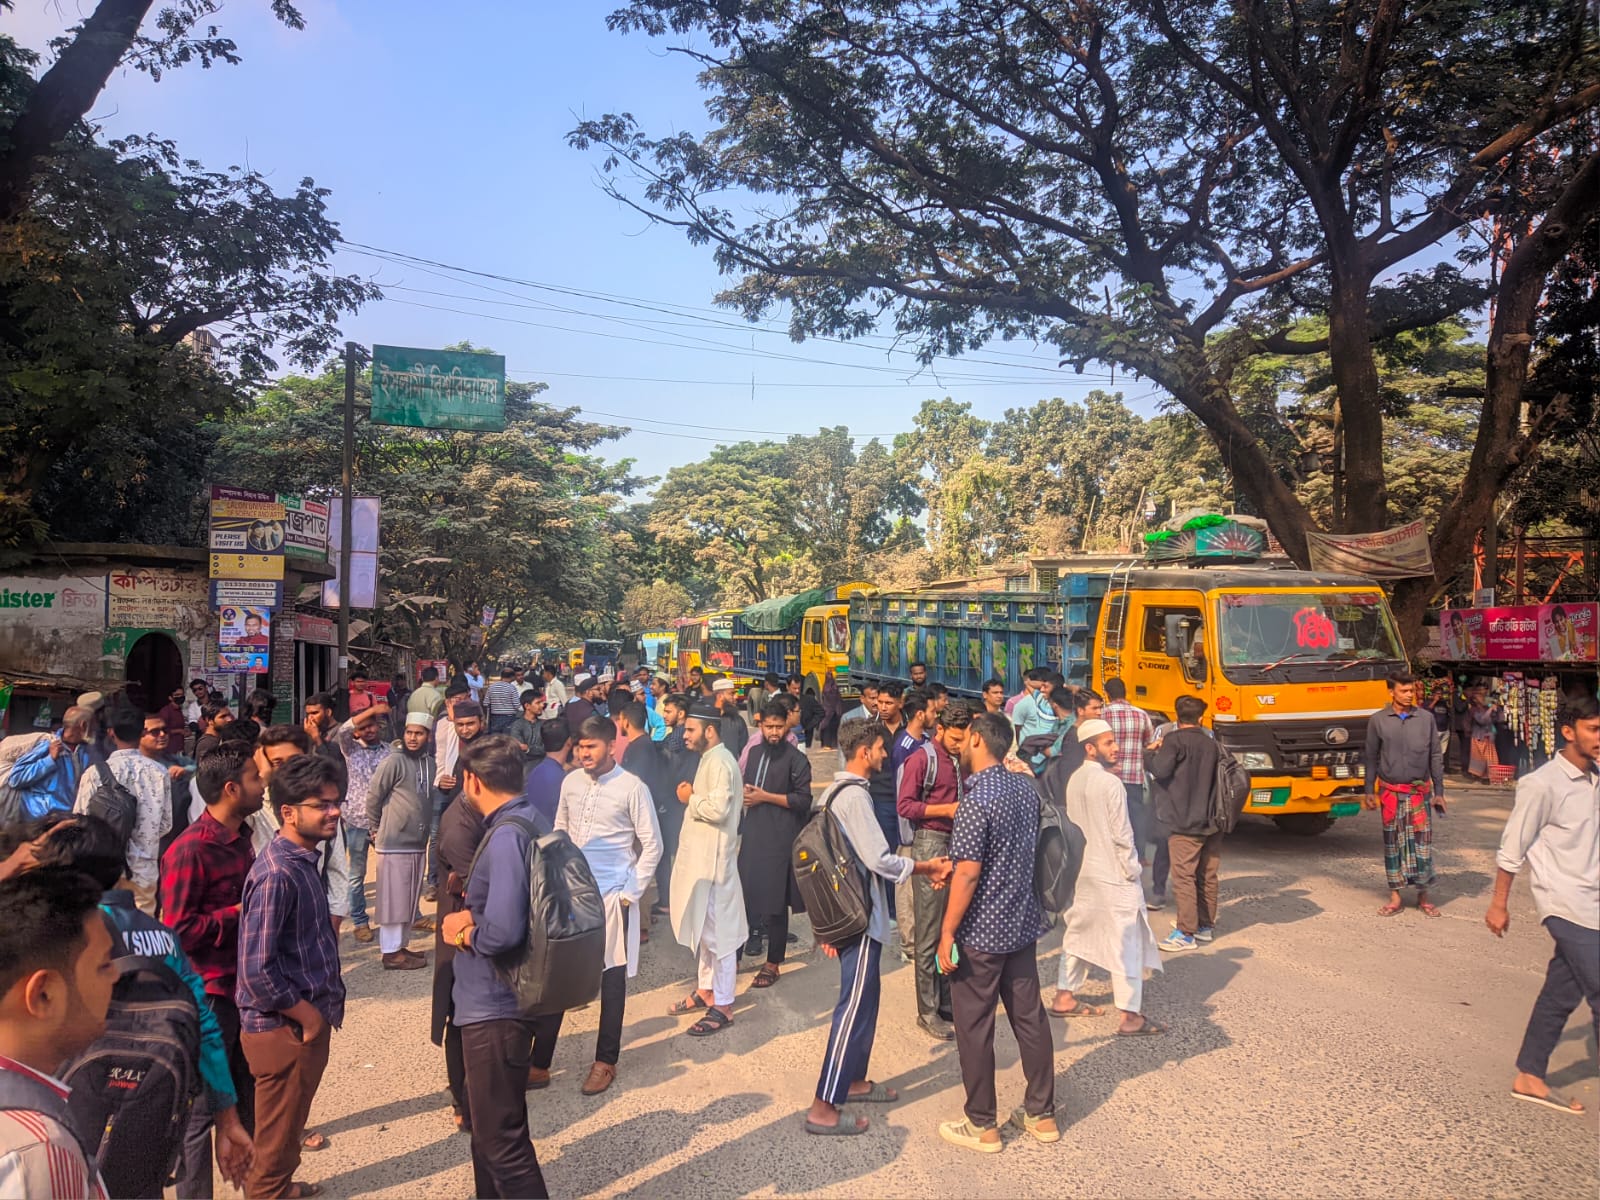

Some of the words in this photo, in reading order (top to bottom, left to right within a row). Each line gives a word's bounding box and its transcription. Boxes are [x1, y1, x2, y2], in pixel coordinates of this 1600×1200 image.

[380, 361, 425, 400] ইসলামী
[429, 364, 498, 404] বিশ্ববিদ্যালয়
[215, 533, 241, 542] PLEASE
[1505, 617, 1519, 632] কফি
[1299, 751, 1359, 766] EICHE
